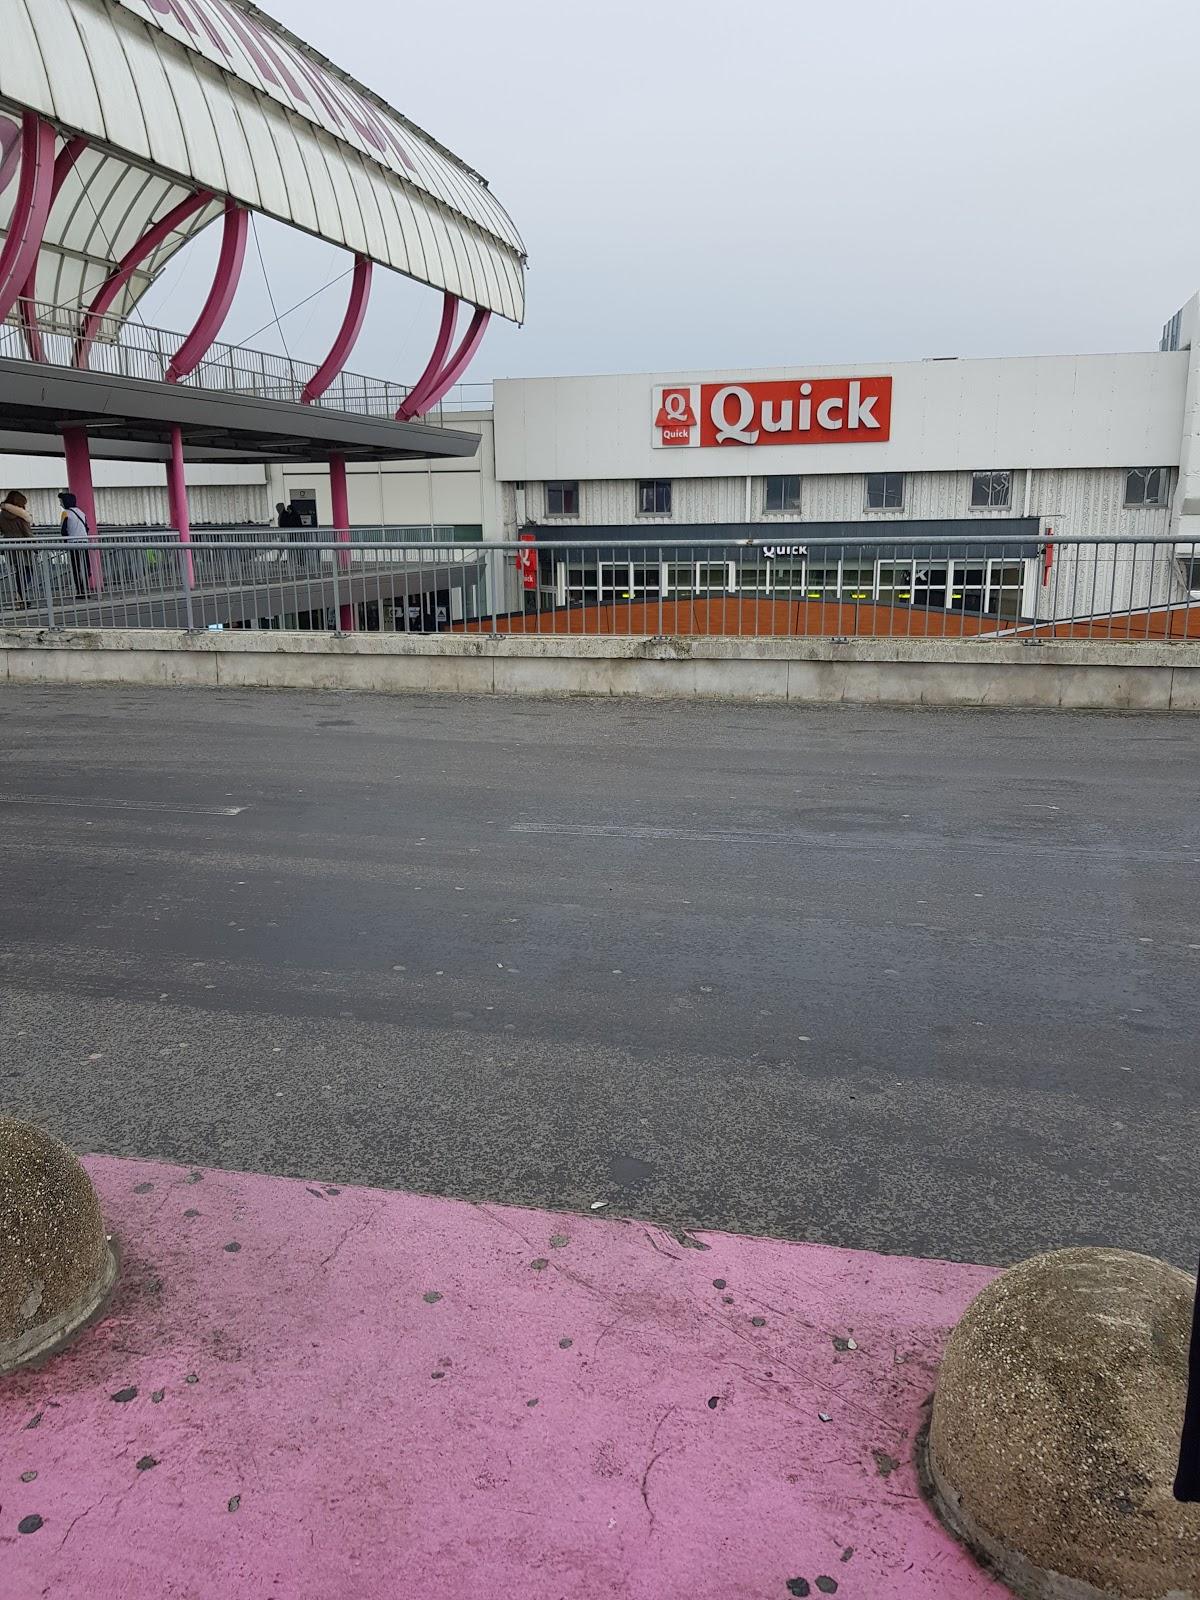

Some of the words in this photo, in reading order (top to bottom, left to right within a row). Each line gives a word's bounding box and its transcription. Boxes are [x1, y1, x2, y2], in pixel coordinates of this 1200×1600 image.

[665, 393, 688, 421] Q
[711, 381, 881, 445] Quick
[663, 428, 689, 440] Quick
[763, 545, 808, 558] Quick
